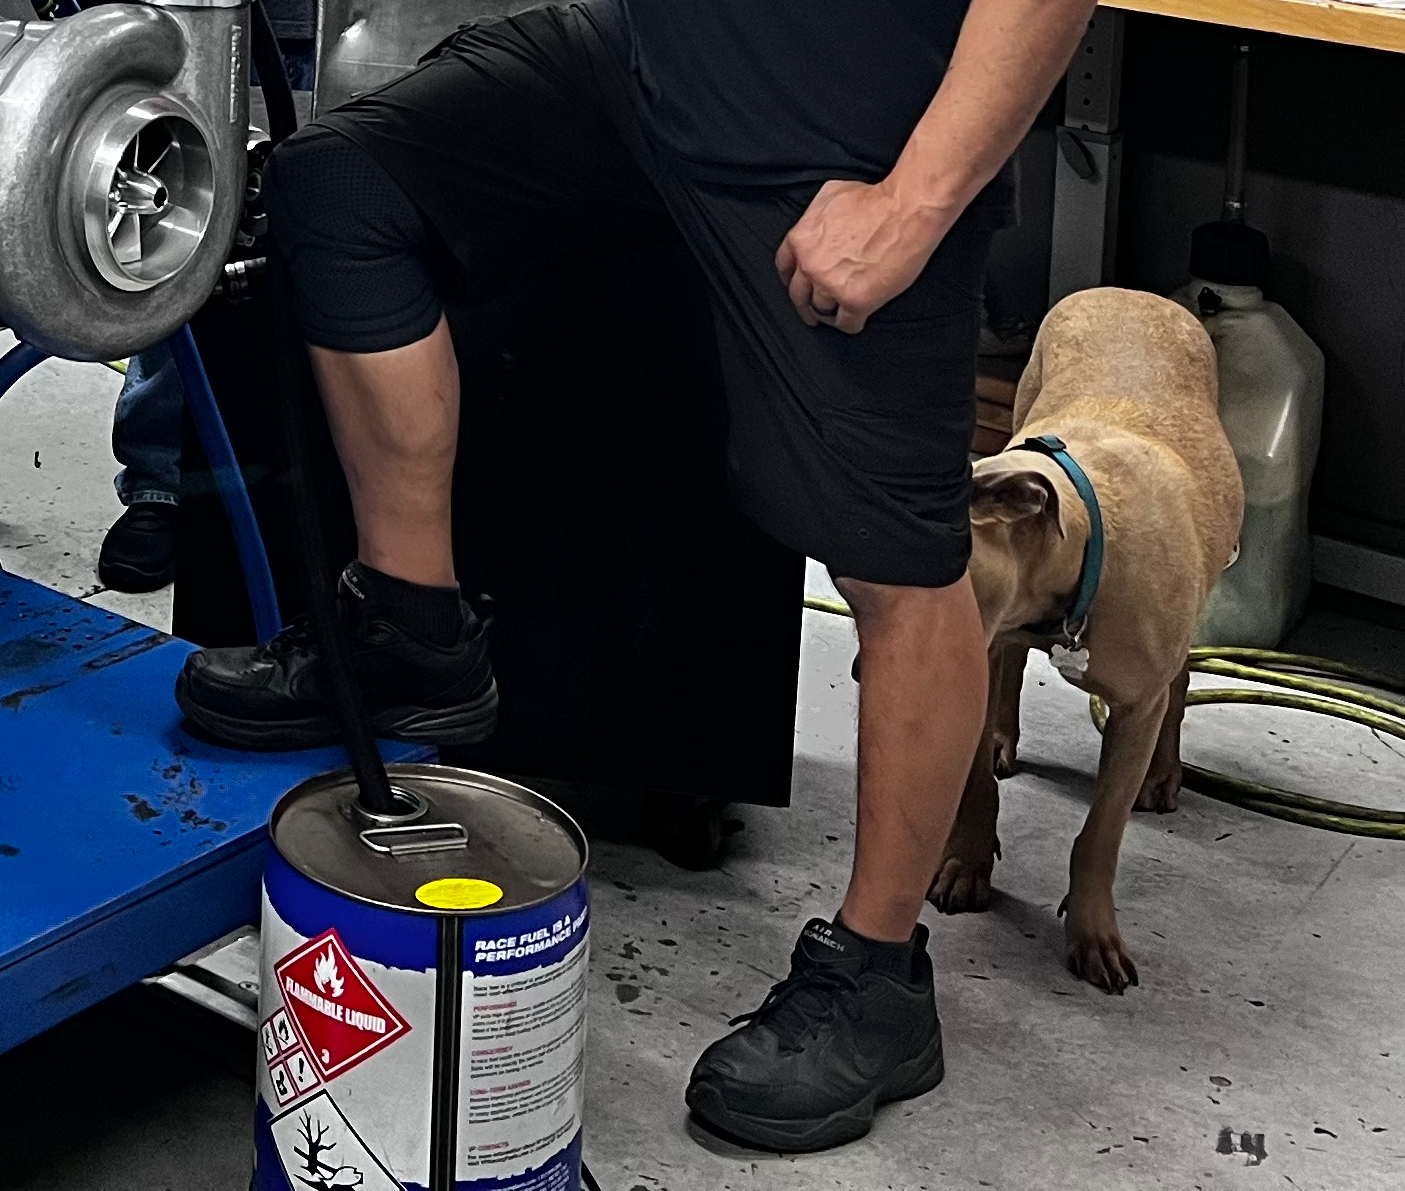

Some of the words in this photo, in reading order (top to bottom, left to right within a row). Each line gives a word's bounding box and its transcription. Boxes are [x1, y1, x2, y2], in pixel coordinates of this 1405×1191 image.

[475, 936, 516, 951] RACE
[520, 927, 551, 945] FUEL
[552, 919, 563, 934] IS
[564, 914, 572, 926] A
[475, 925, 571, 963] PERFORMANCE
[286, 975, 344, 1022] FLAMMABLE
[345, 1007, 386, 1034] LIQUID
[321, 1048, 330, 1064] 3
